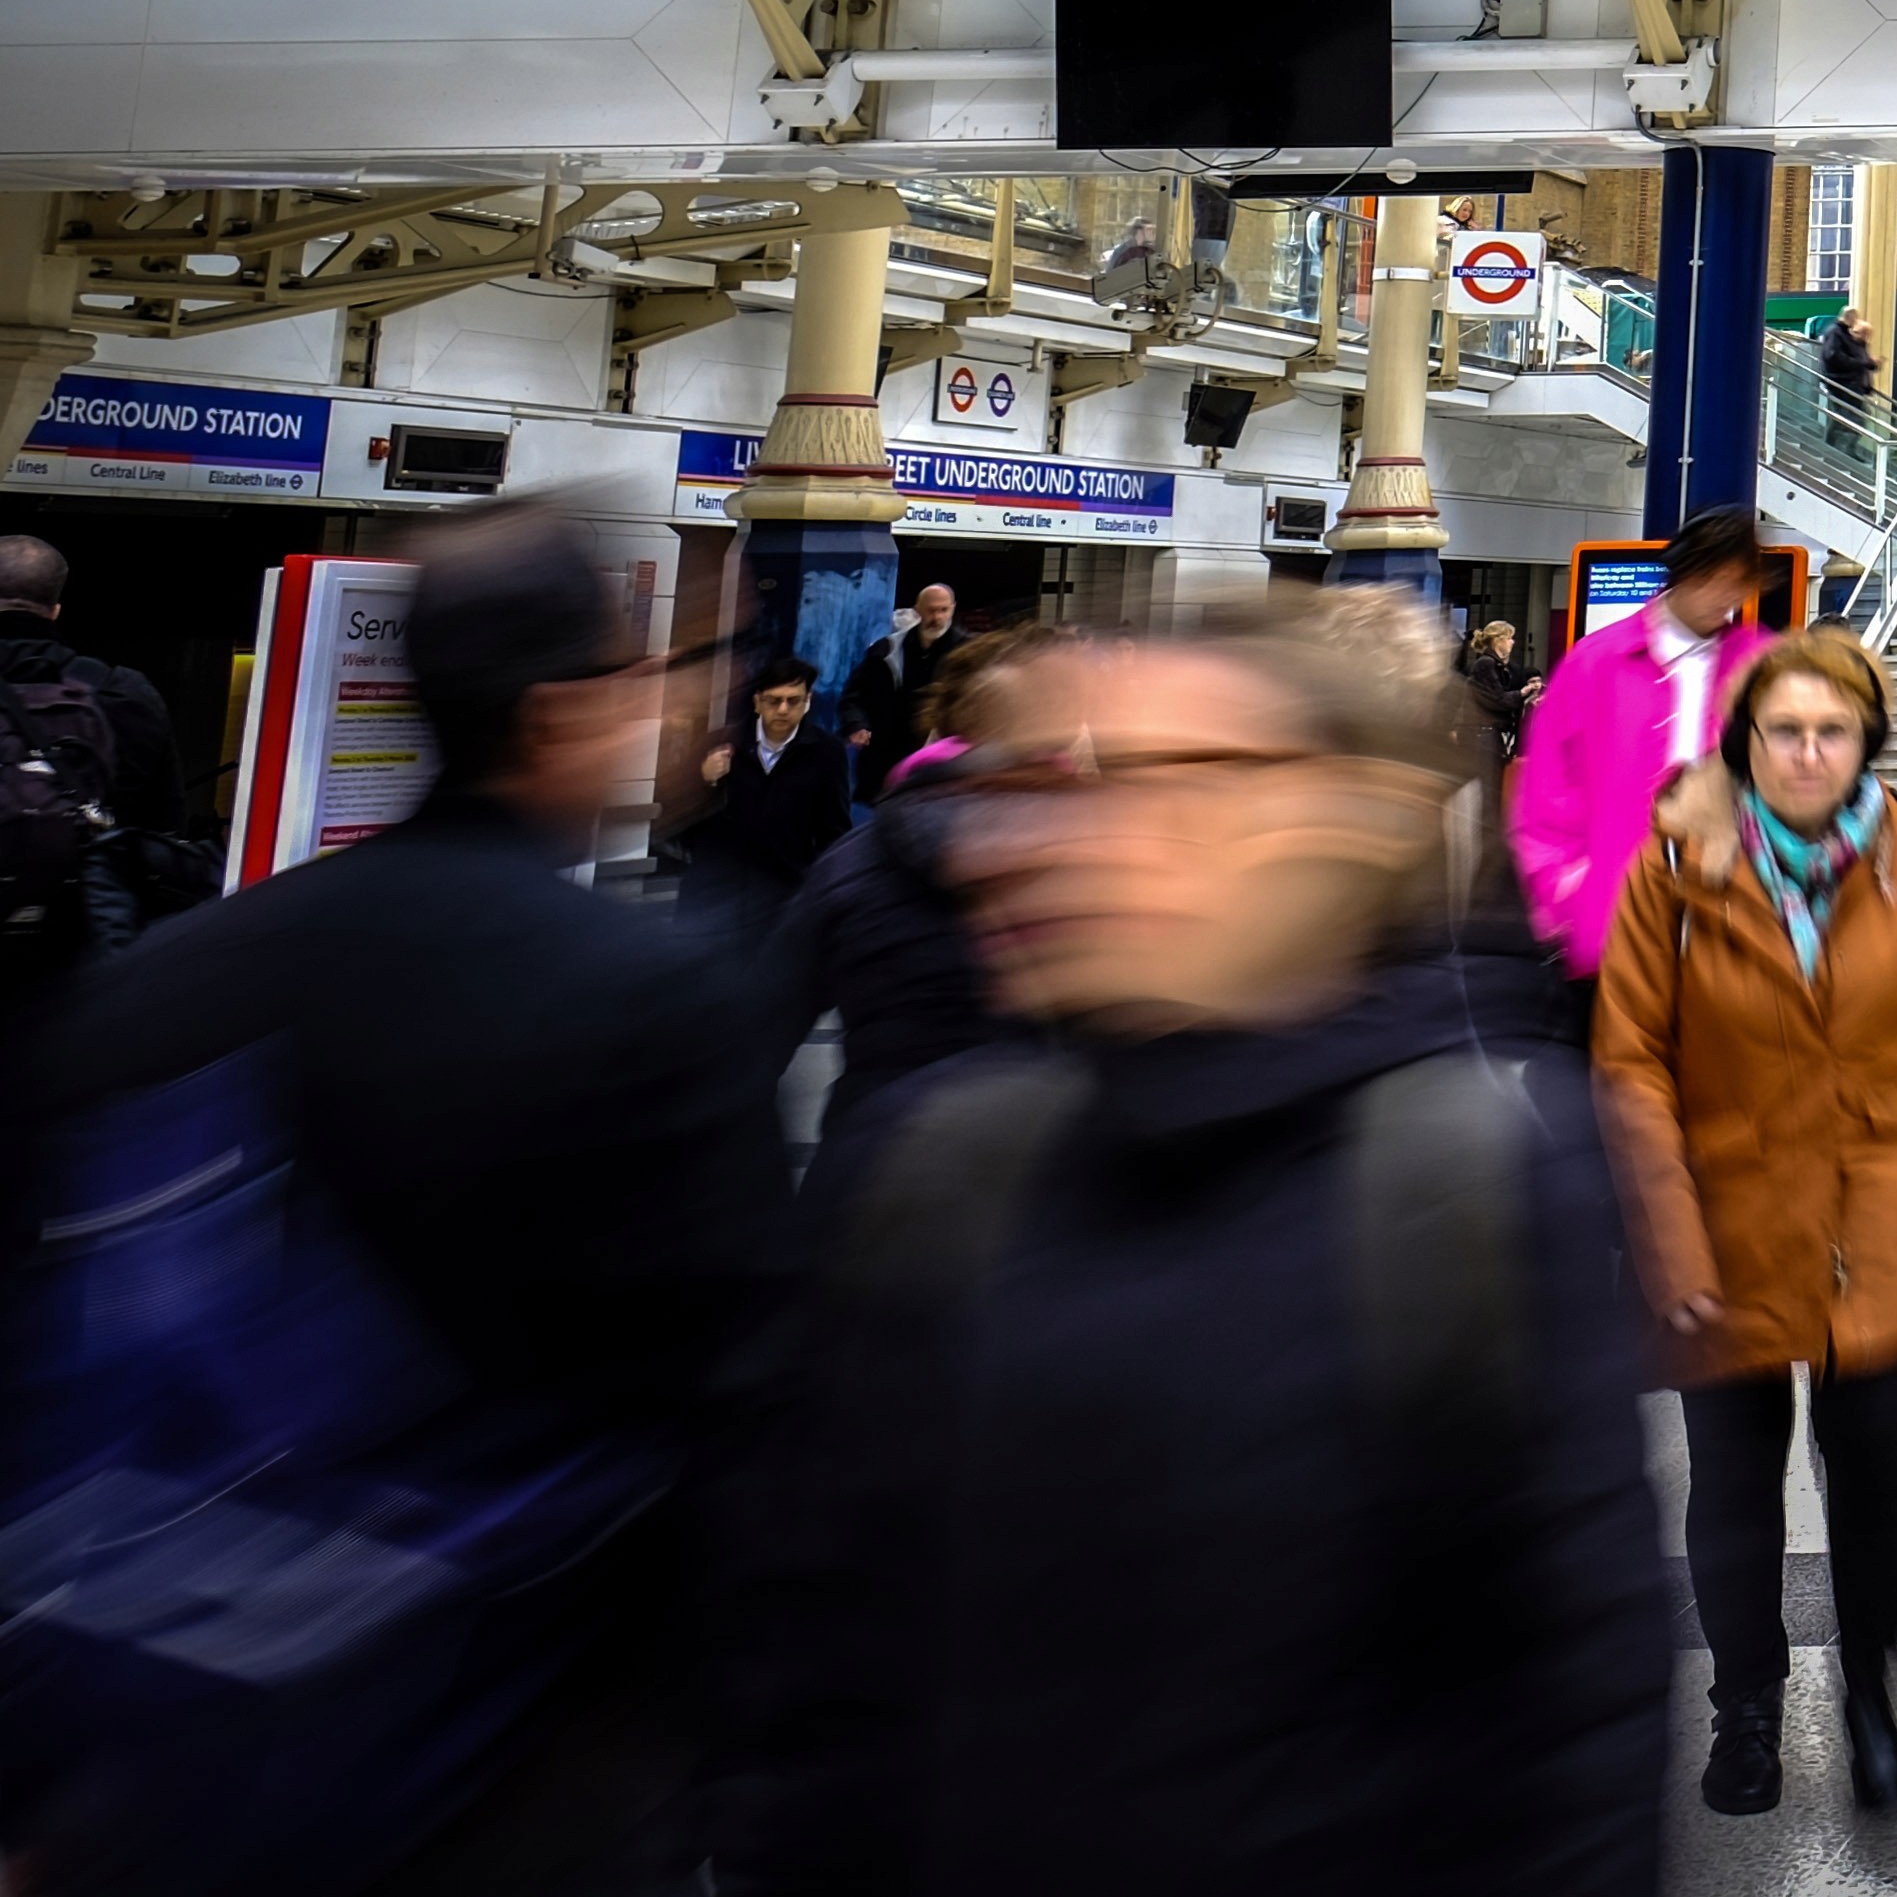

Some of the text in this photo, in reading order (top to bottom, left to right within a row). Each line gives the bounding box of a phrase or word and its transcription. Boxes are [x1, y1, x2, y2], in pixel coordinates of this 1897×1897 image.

[1457, 268, 1530, 277] UNDERGROUND
[37, 396, 302, 439] DERGROUND STATION
[17, 460, 286, 488] lines Central Line Elizabeth line
[935, 458, 1074, 494] UNDERGROUND
[1078, 470, 1144, 499] STATION
[934, 508, 956, 523] lines
[1003, 512, 1033, 527] Central
[1036, 514, 1052, 528] line
[1096, 518, 1130, 532] Elizabeth
[1132, 520, 1146, 532] line
[347, 611, 405, 640] Serv
[342, 654, 377, 667] Week
